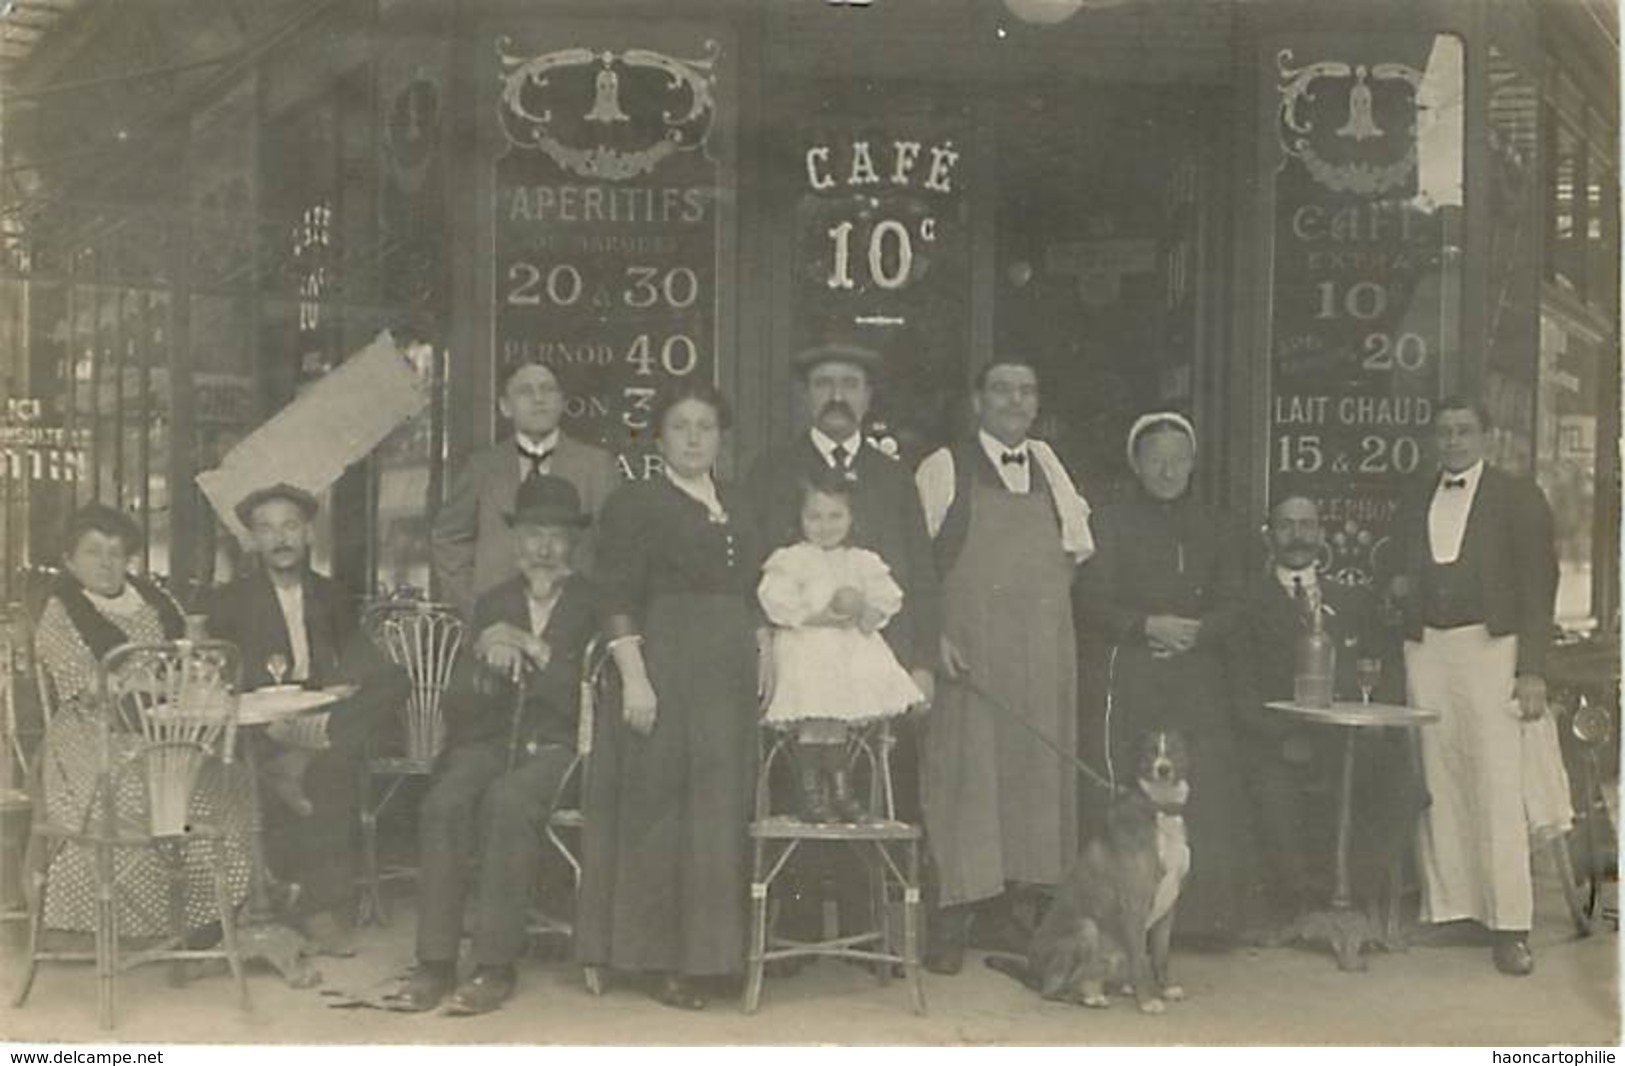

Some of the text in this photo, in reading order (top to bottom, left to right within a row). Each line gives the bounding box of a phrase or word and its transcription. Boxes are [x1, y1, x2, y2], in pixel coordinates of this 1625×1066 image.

[805, 139, 960, 194] CAFÉ
[509, 185, 705, 223] APERITIFS
[507, 262, 583, 307] 20
[623, 266, 699, 309] 30
[624, 333, 699, 377] 40
[1361, 331, 1429, 372] 20
[565, 386, 657, 430] ON 3
[1275, 394, 1433, 426] LAIT CHAUD
[616, 453, 665, 482] AR
[1277, 434, 1324, 474] 15
[1358, 434, 1420, 475] 20
